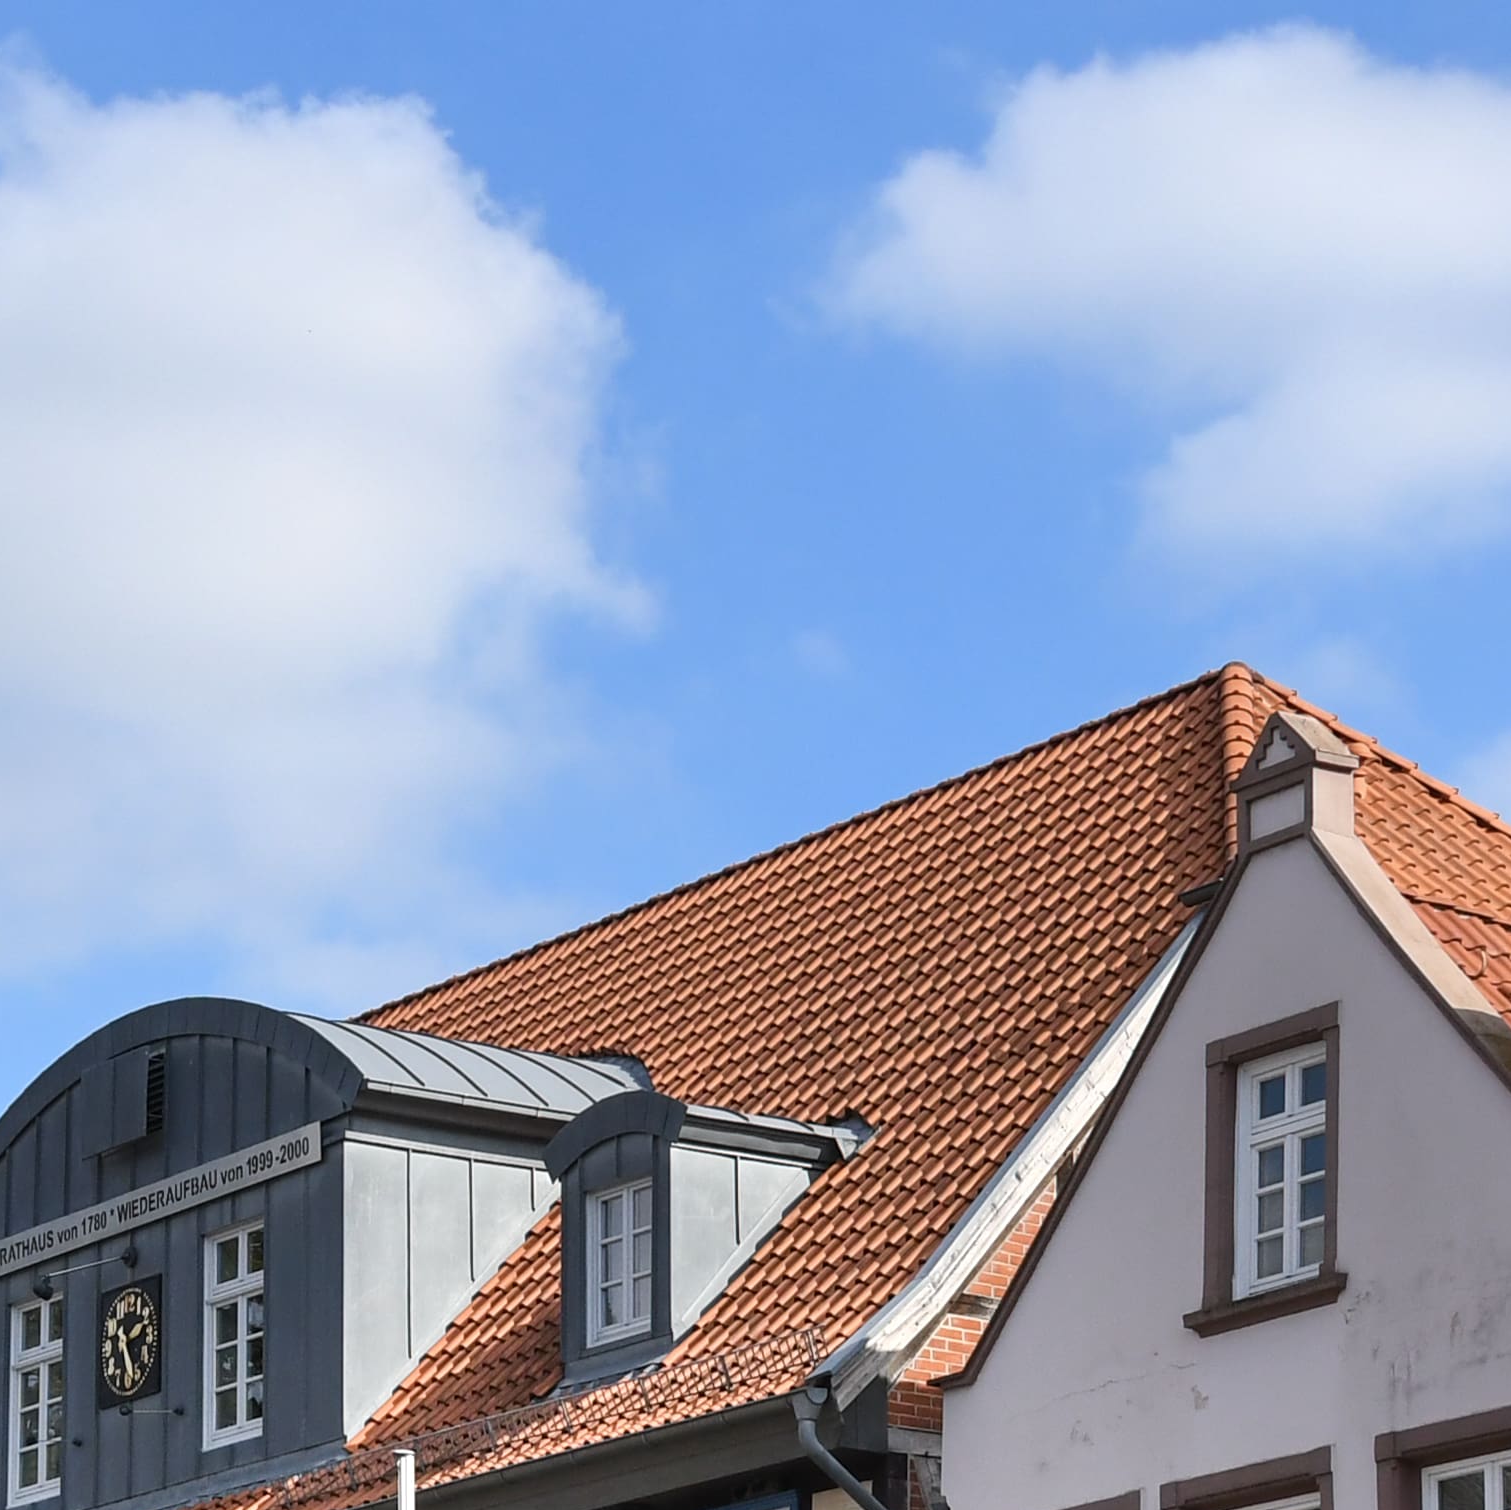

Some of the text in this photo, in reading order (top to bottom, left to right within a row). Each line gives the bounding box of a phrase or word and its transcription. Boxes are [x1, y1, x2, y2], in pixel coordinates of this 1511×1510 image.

[57, 1224, 79, 1245] von
[81, 1211, 108, 1241] 1780
[117, 1169, 218, 1224] WIEDERAUFBAU
[220, 1164, 244, 1187] von
[124, 1293, 136, 1313] 12
[142, 1306, 150, 1325] 2
[145, 1324, 153, 1344] 3
